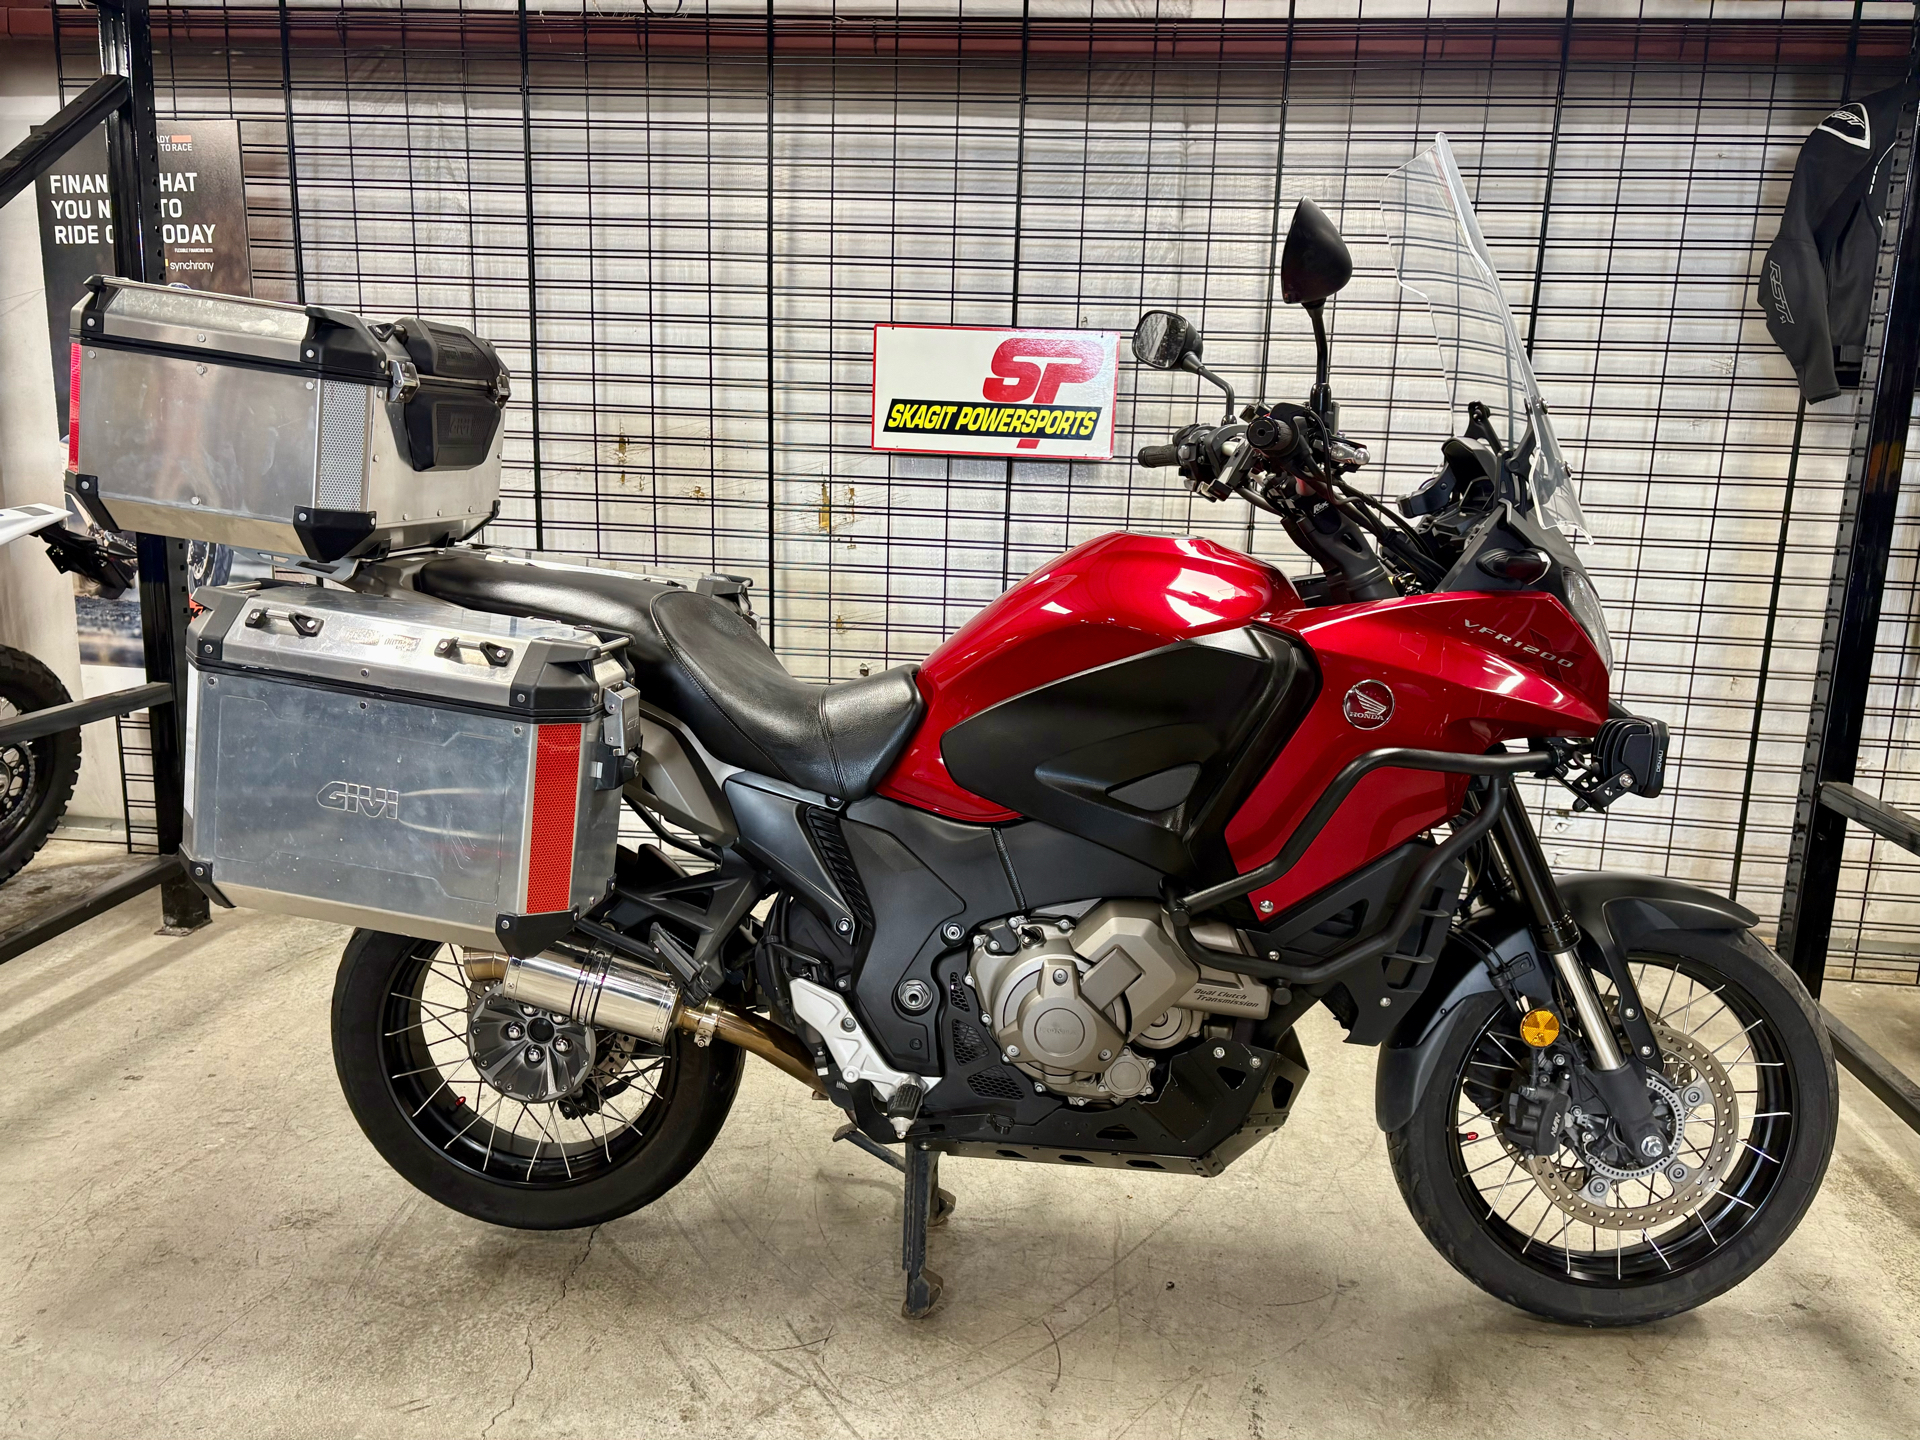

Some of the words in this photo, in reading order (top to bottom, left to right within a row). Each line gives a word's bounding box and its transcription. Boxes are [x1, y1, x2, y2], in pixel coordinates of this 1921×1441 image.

[160, 143, 171, 152] TO
[171, 143, 193, 152] RACE
[159, 172, 198, 192] HAT
[51, 199, 92, 220] YOU
[160, 198, 183, 218] TO
[54, 224, 100, 245] RIDE
[162, 223, 216, 244] ODAY
[169, 260, 215, 273] synchrony
[1769, 259, 1795, 325] RST
[887, 403, 959, 430] SKAGIT
[954, 406, 1098, 437] POWERSPORTS
[1464, 618, 1574, 668] VFR1200
[1349, 711, 1385, 721] HONDA
[316, 780, 400, 820] GIVI
[1193, 988, 1218, 997] Dual
[1217, 991, 1248, 1000] Clutch
[1196, 994, 1260, 1008] Transmission
